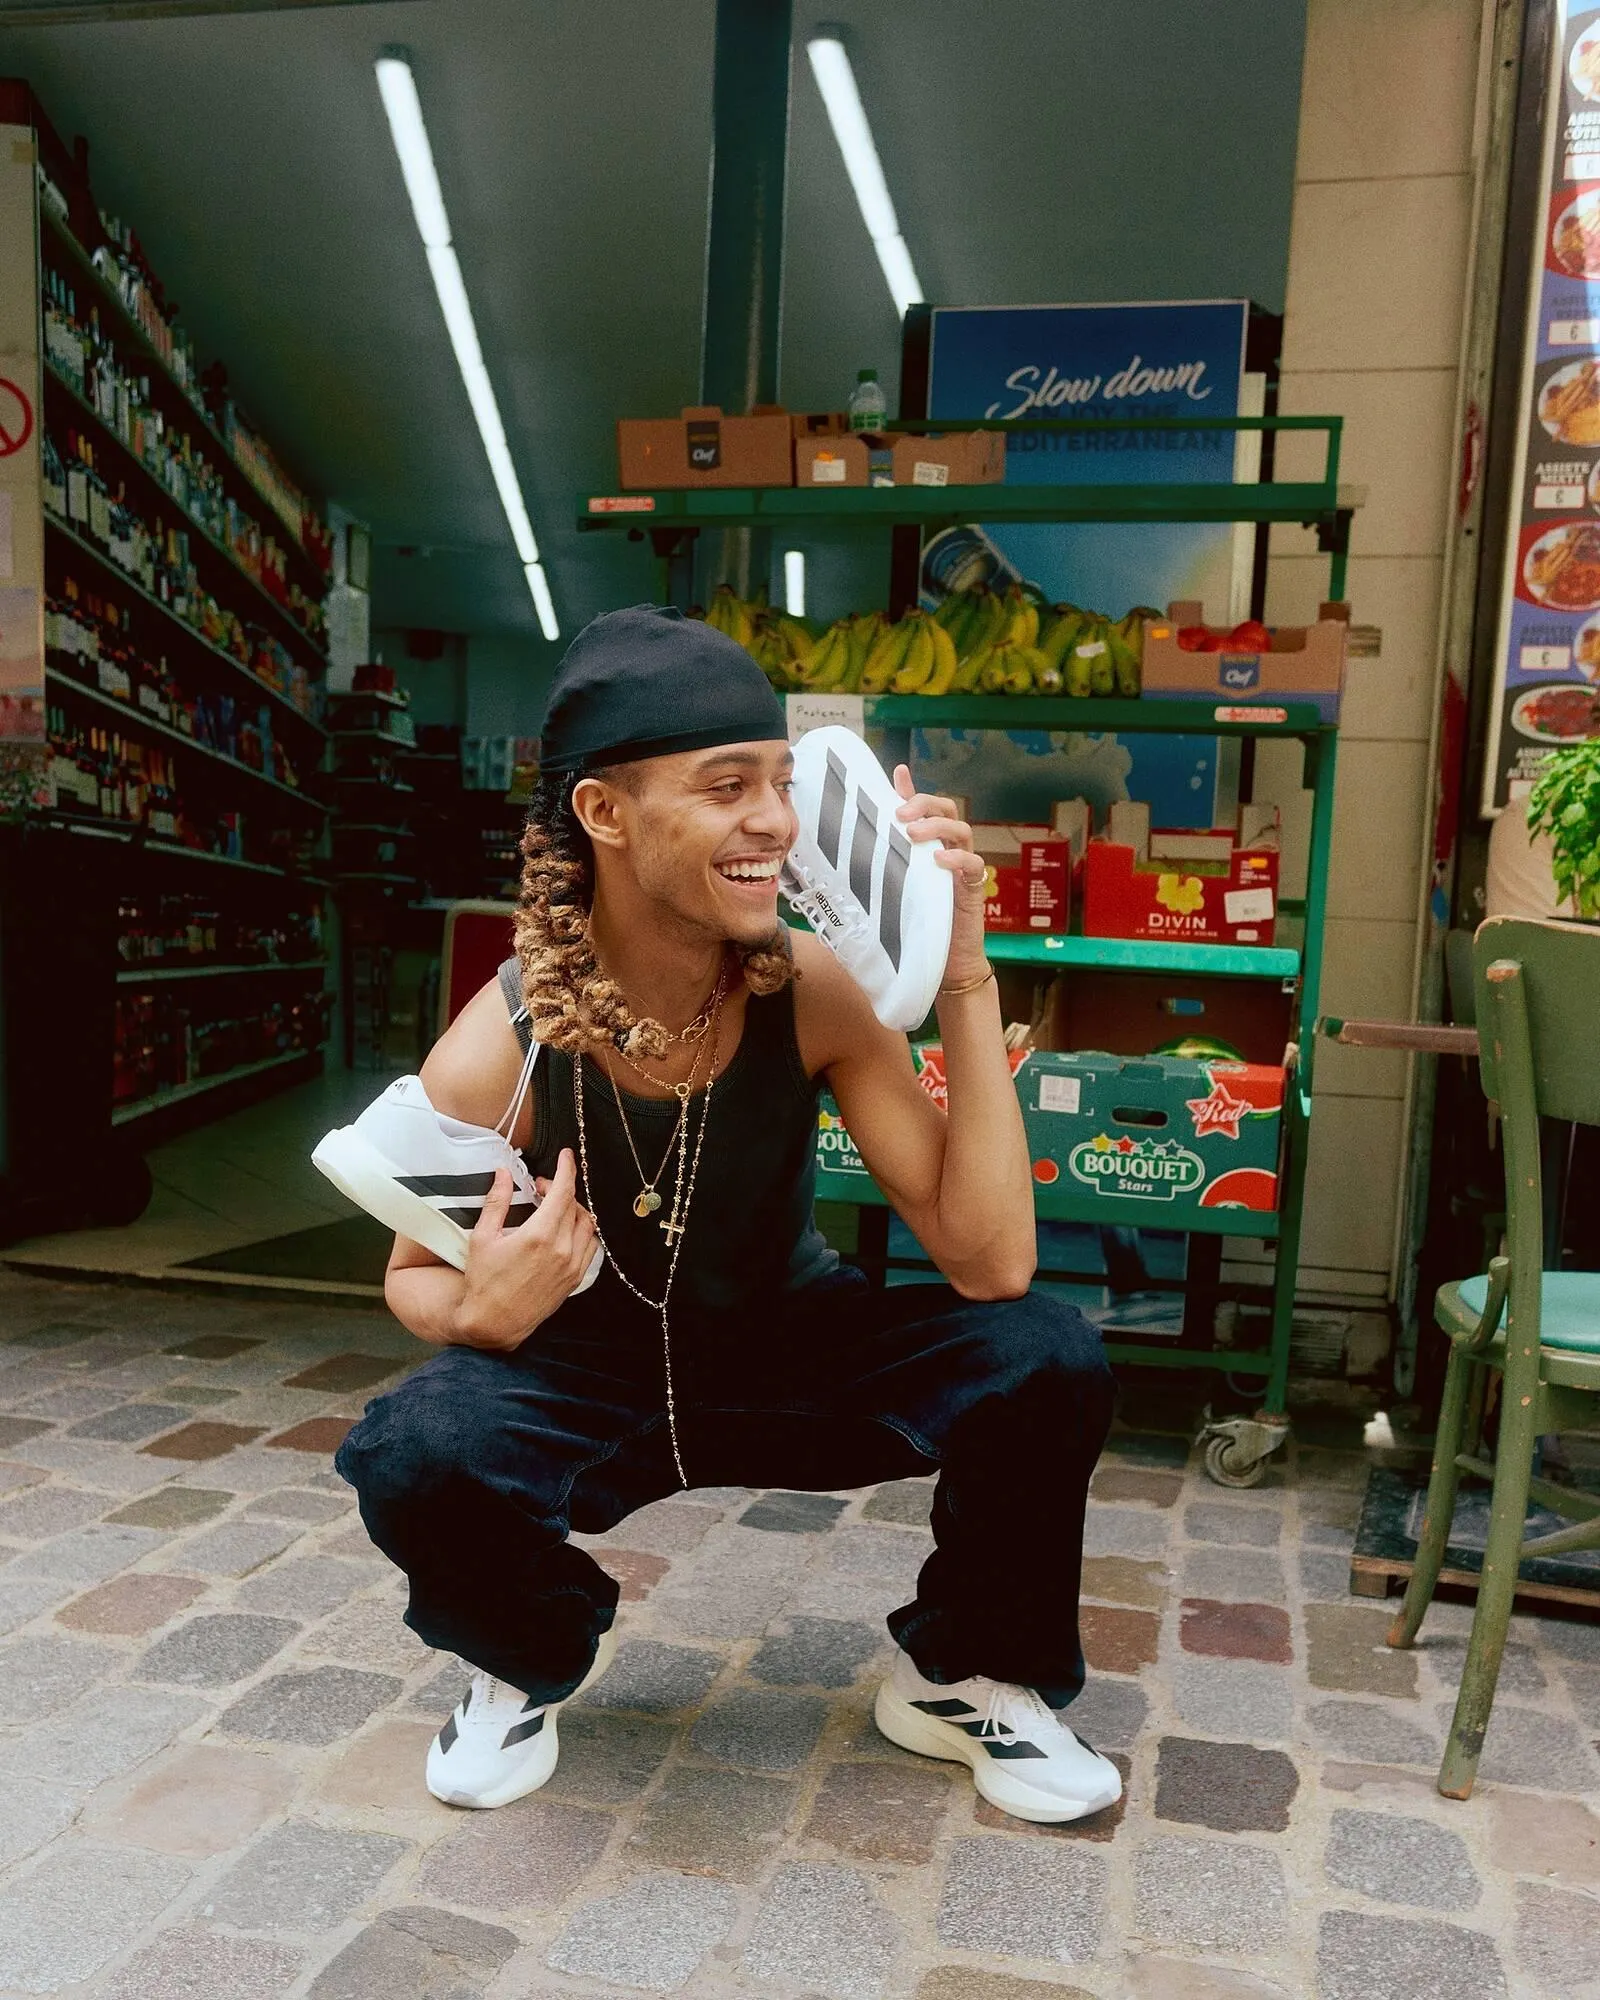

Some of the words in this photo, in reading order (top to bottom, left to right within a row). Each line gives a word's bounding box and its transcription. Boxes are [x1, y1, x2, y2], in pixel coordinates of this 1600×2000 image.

[985, 365, 1101, 420] Slow
[1103, 355, 1213, 400] down
[1005, 430, 1222, 452] EDITERRANEAN
[1147, 912, 1207, 930] DIVIN
[1192, 1099, 1253, 1123] Red
[841, 1155, 865, 1167] Sta
[1083, 1152, 1192, 1181] BOUQUET
[1118, 1178, 1153, 1193] Stars
